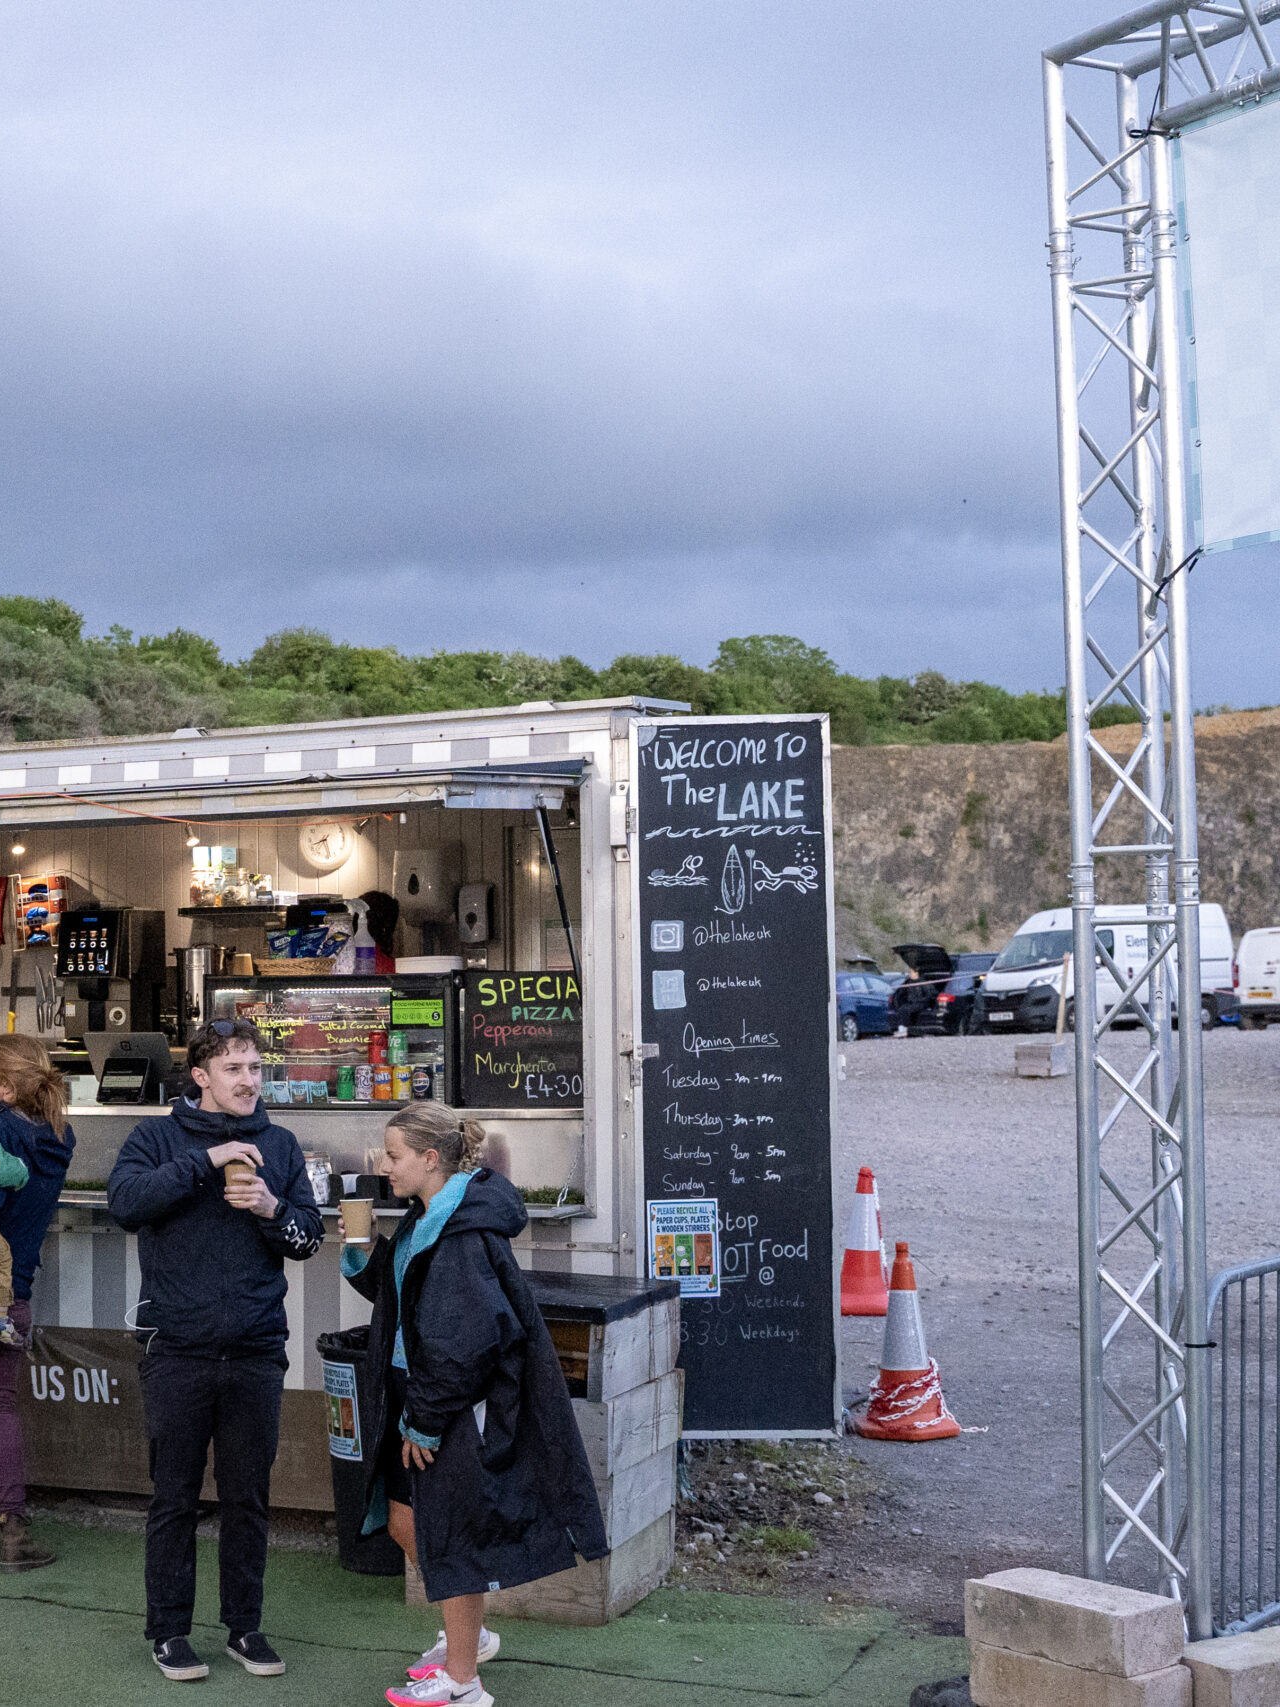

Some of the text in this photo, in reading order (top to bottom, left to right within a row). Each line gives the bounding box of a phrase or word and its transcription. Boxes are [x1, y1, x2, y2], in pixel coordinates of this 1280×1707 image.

[774, 732, 807, 762] TO
[660, 773, 805, 821] The LAKE
[478, 975, 580, 1006] SPECIA
[318, 1020, 346, 1031] Salted
[325, 1033, 372, 1043] Brownie
[473, 1013, 552, 1046] Pepperoni
[683, 1019, 779, 1058] Opening times
[662, 1064, 720, 1090] Tuesday
[663, 1102, 724, 1135] Thursday
[663, 1145, 712, 1166] Saturday
[663, 1173, 705, 1197] Sunday
[656, 1206, 708, 1215] PLEASE RECYCLE ALL
[656, 1216, 673, 1224] PAPER
[685, 1224, 710, 1232] STIRRERS
[759, 1228, 808, 1263] Food
[31, 1365, 120, 1404] US ON:
